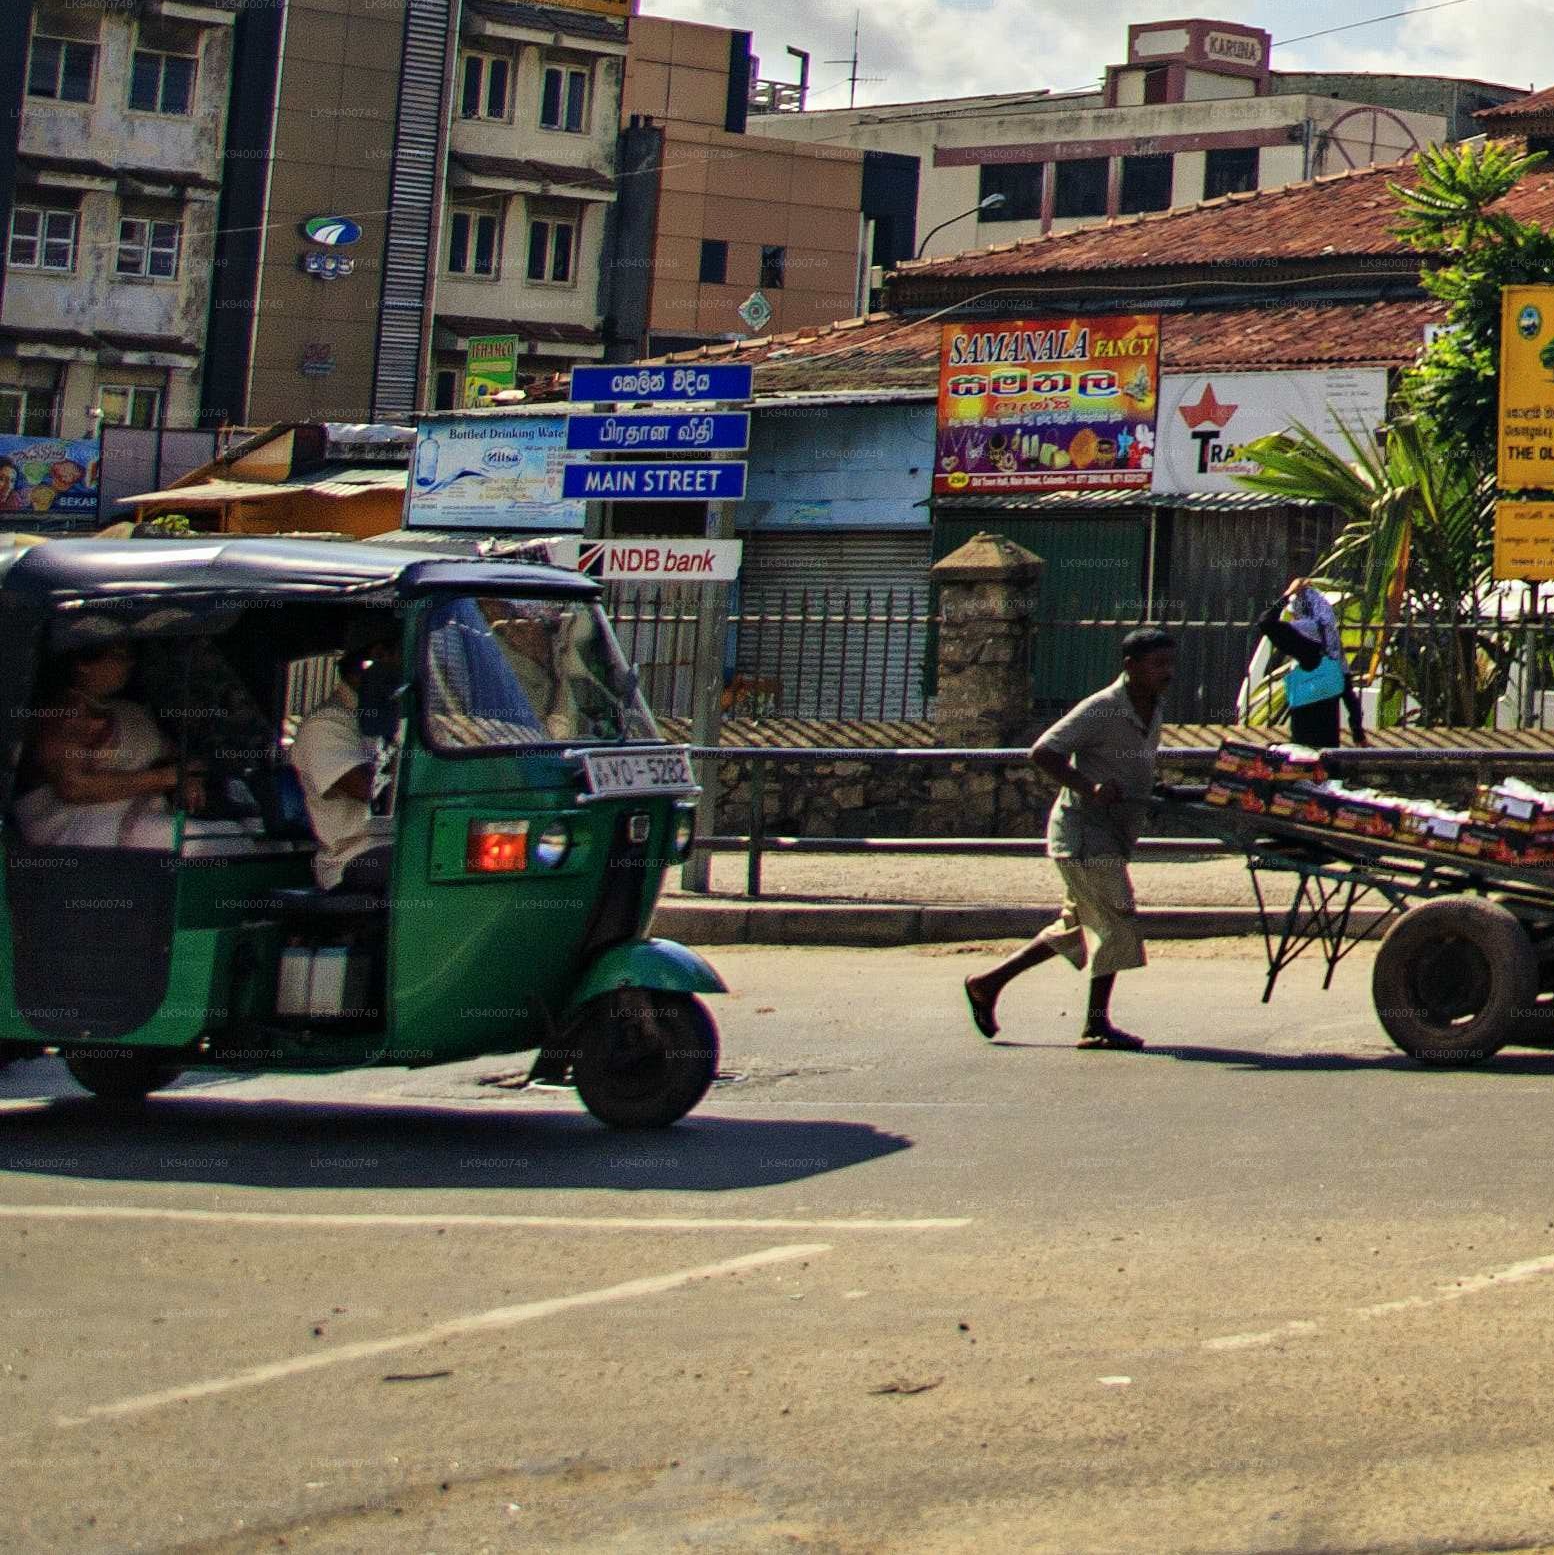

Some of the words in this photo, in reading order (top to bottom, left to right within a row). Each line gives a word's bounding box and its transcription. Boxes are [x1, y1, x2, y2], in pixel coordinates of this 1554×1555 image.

[948, 327, 1091, 367] SAMANALA
[1093, 336, 1154, 358] FANCY
[448, 428, 486, 440] Bottled
[490, 427, 535, 441] Drinking
[599, 418, 671, 447] பிரதான
[677, 417, 715, 446] வீதி
[1507, 446, 1534, 460] THE
[585, 470, 636, 493] MAIN
[642, 469, 722, 493] STREET
[608, 547, 660, 573] NDB
[663, 547, 717, 573] bank
